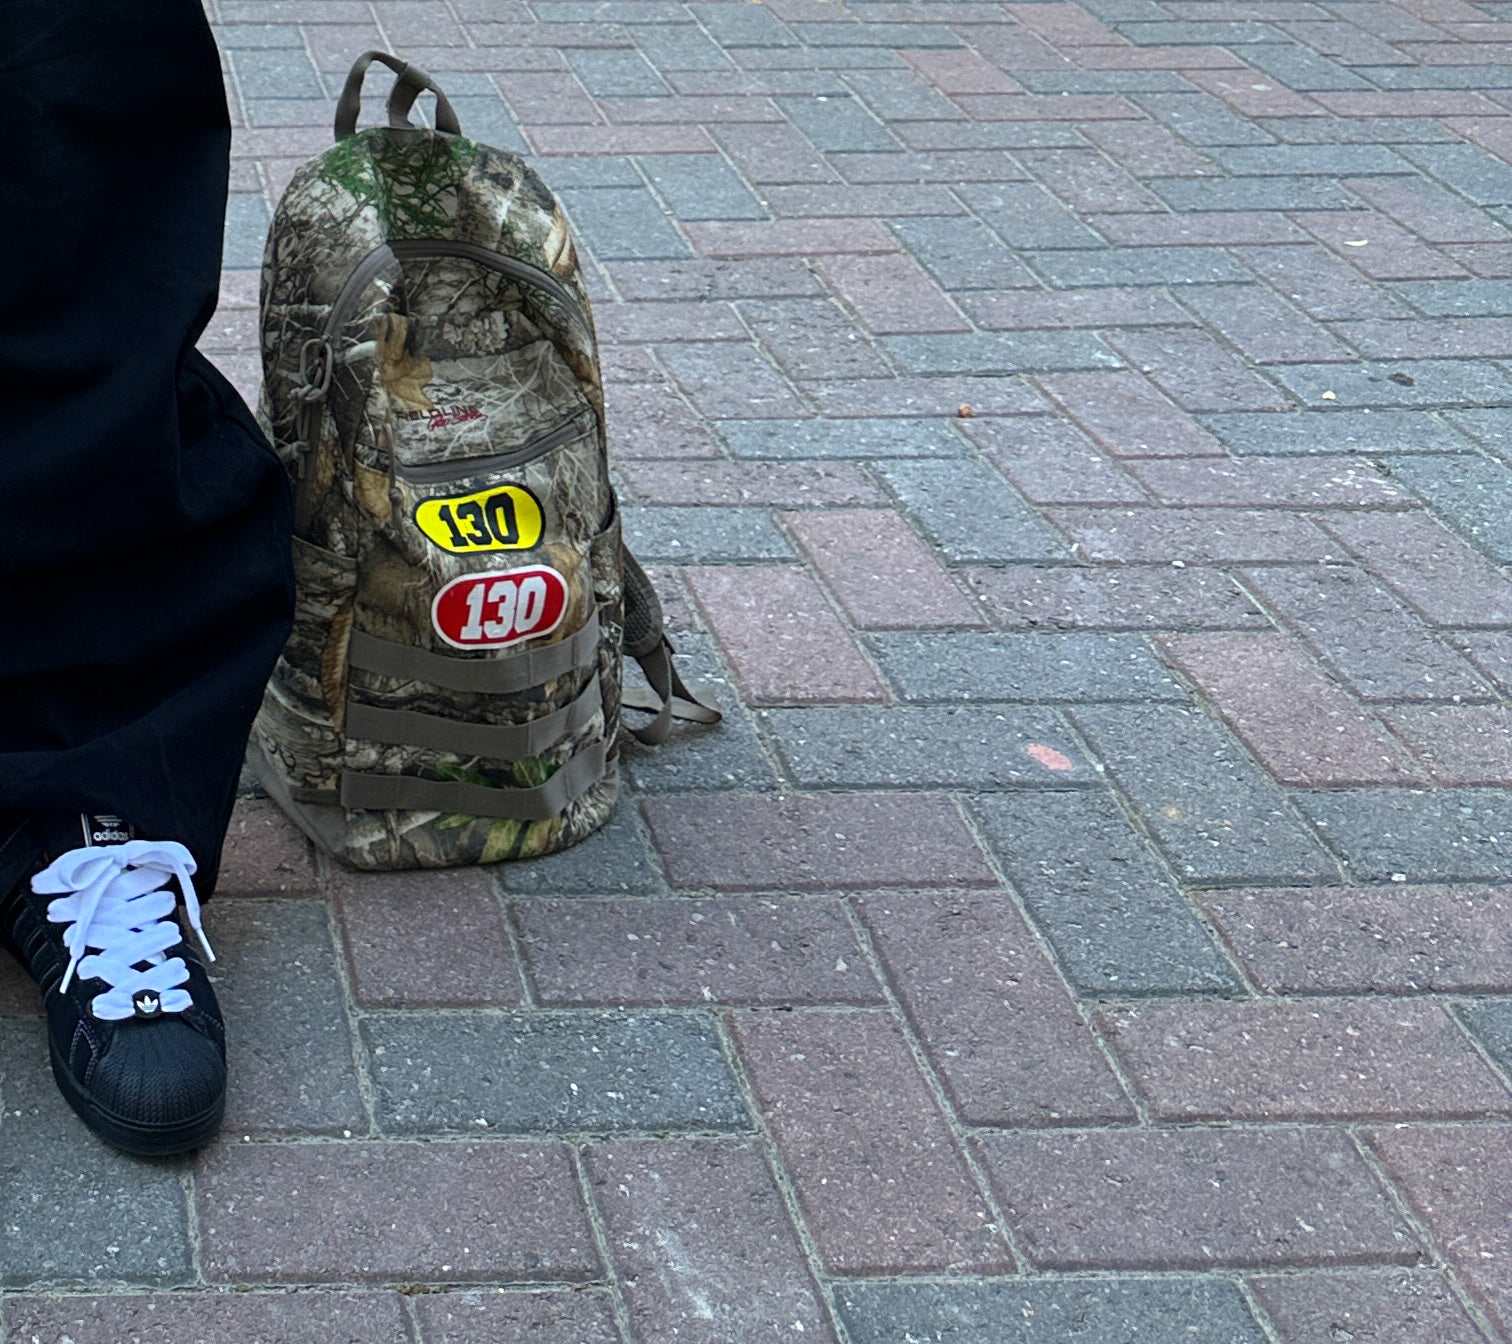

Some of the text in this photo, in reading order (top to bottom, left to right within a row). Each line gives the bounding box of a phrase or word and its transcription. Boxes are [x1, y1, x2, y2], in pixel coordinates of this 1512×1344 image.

[439, 492, 520, 548] 130
[459, 576, 547, 641] 130
[92, 828, 129, 842] adidas
